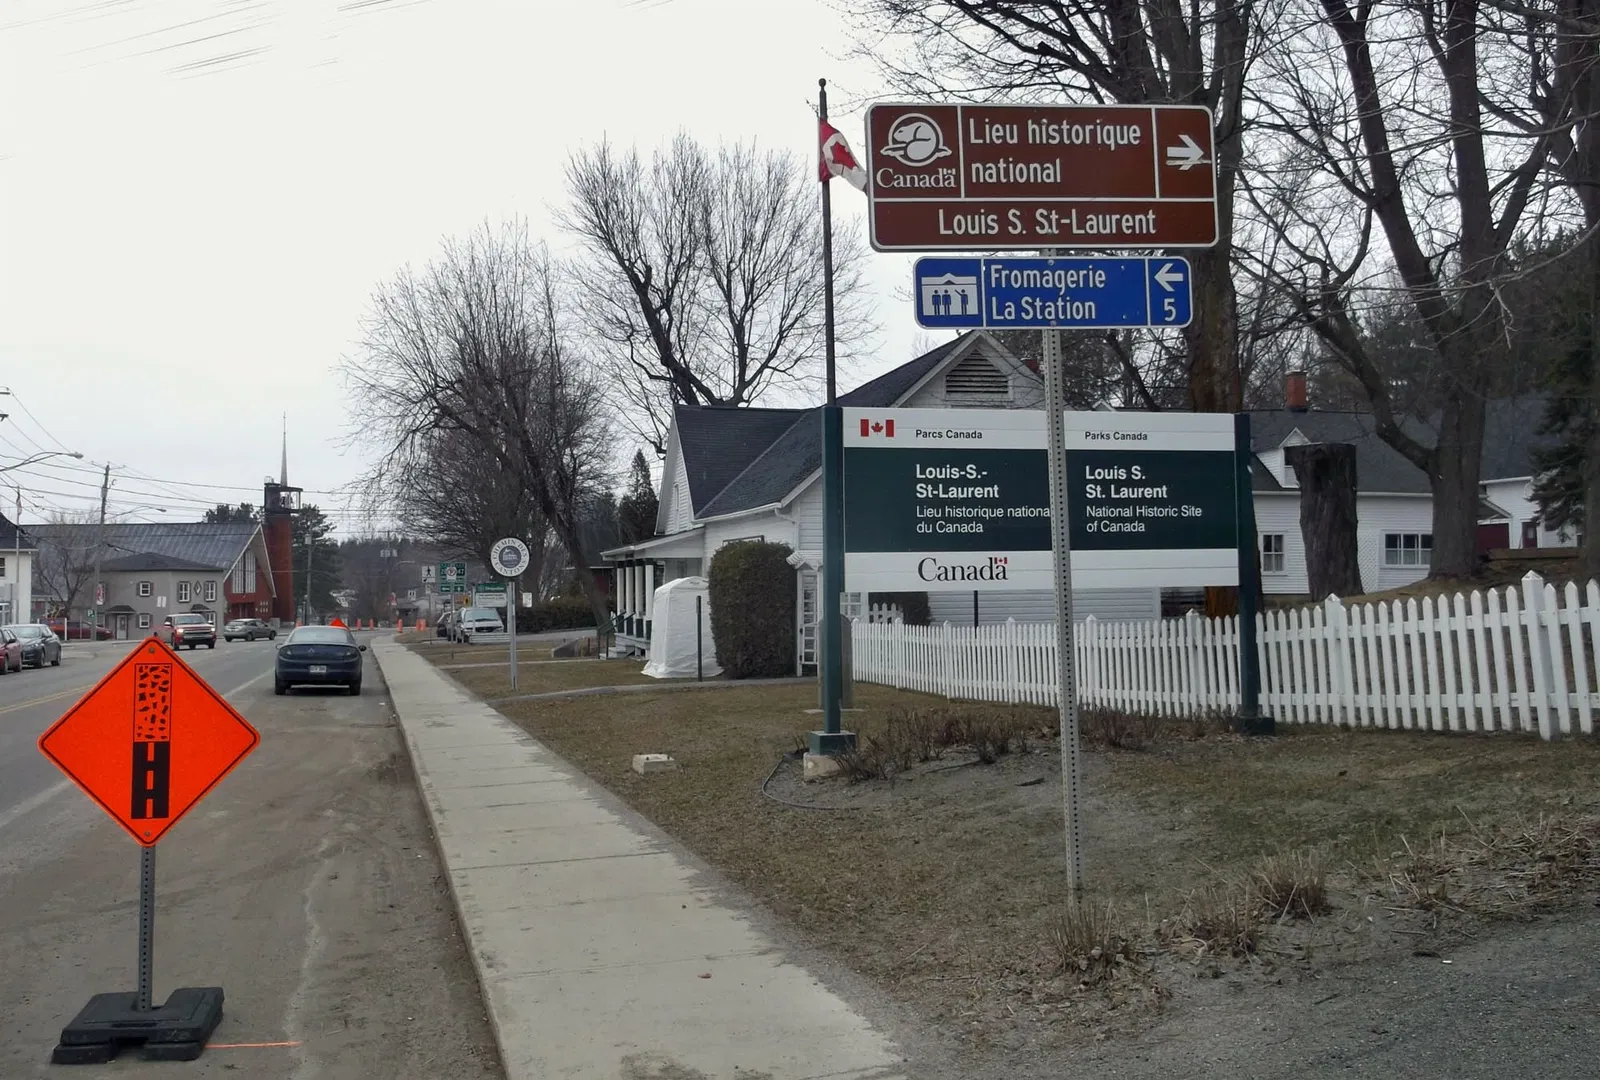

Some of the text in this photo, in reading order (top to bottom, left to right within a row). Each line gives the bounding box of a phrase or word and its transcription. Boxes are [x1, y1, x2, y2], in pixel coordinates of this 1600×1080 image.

[970, 119, 1140, 150] Lieu historique
[972, 158, 1060, 182] national
[877, 167, 957, 188] Canada
[939, 209, 1156, 234] Louis S. St-Laurent
[990, 265, 1106, 295] Fromagerie
[992, 296, 1096, 320] La Station
[1164, 299, 1176, 321] 5
[916, 430, 982, 438] Parcs Canada
[1085, 432, 1147, 440] Parks Canada
[917, 464, 987, 478] Louis-S.-
[1086, 466, 1145, 479] Louis S.
[917, 484, 998, 498] St-Laurent
[1086, 484, 1167, 498] St. Laurent
[917, 506, 1050, 520] Lieu historique nationa
[1087, 505, 1202, 517] National Historic Site
[917, 521, 983, 532] du Canada
[1087, 521, 1145, 532] of Canada
[918, 557, 1007, 581] Canada
